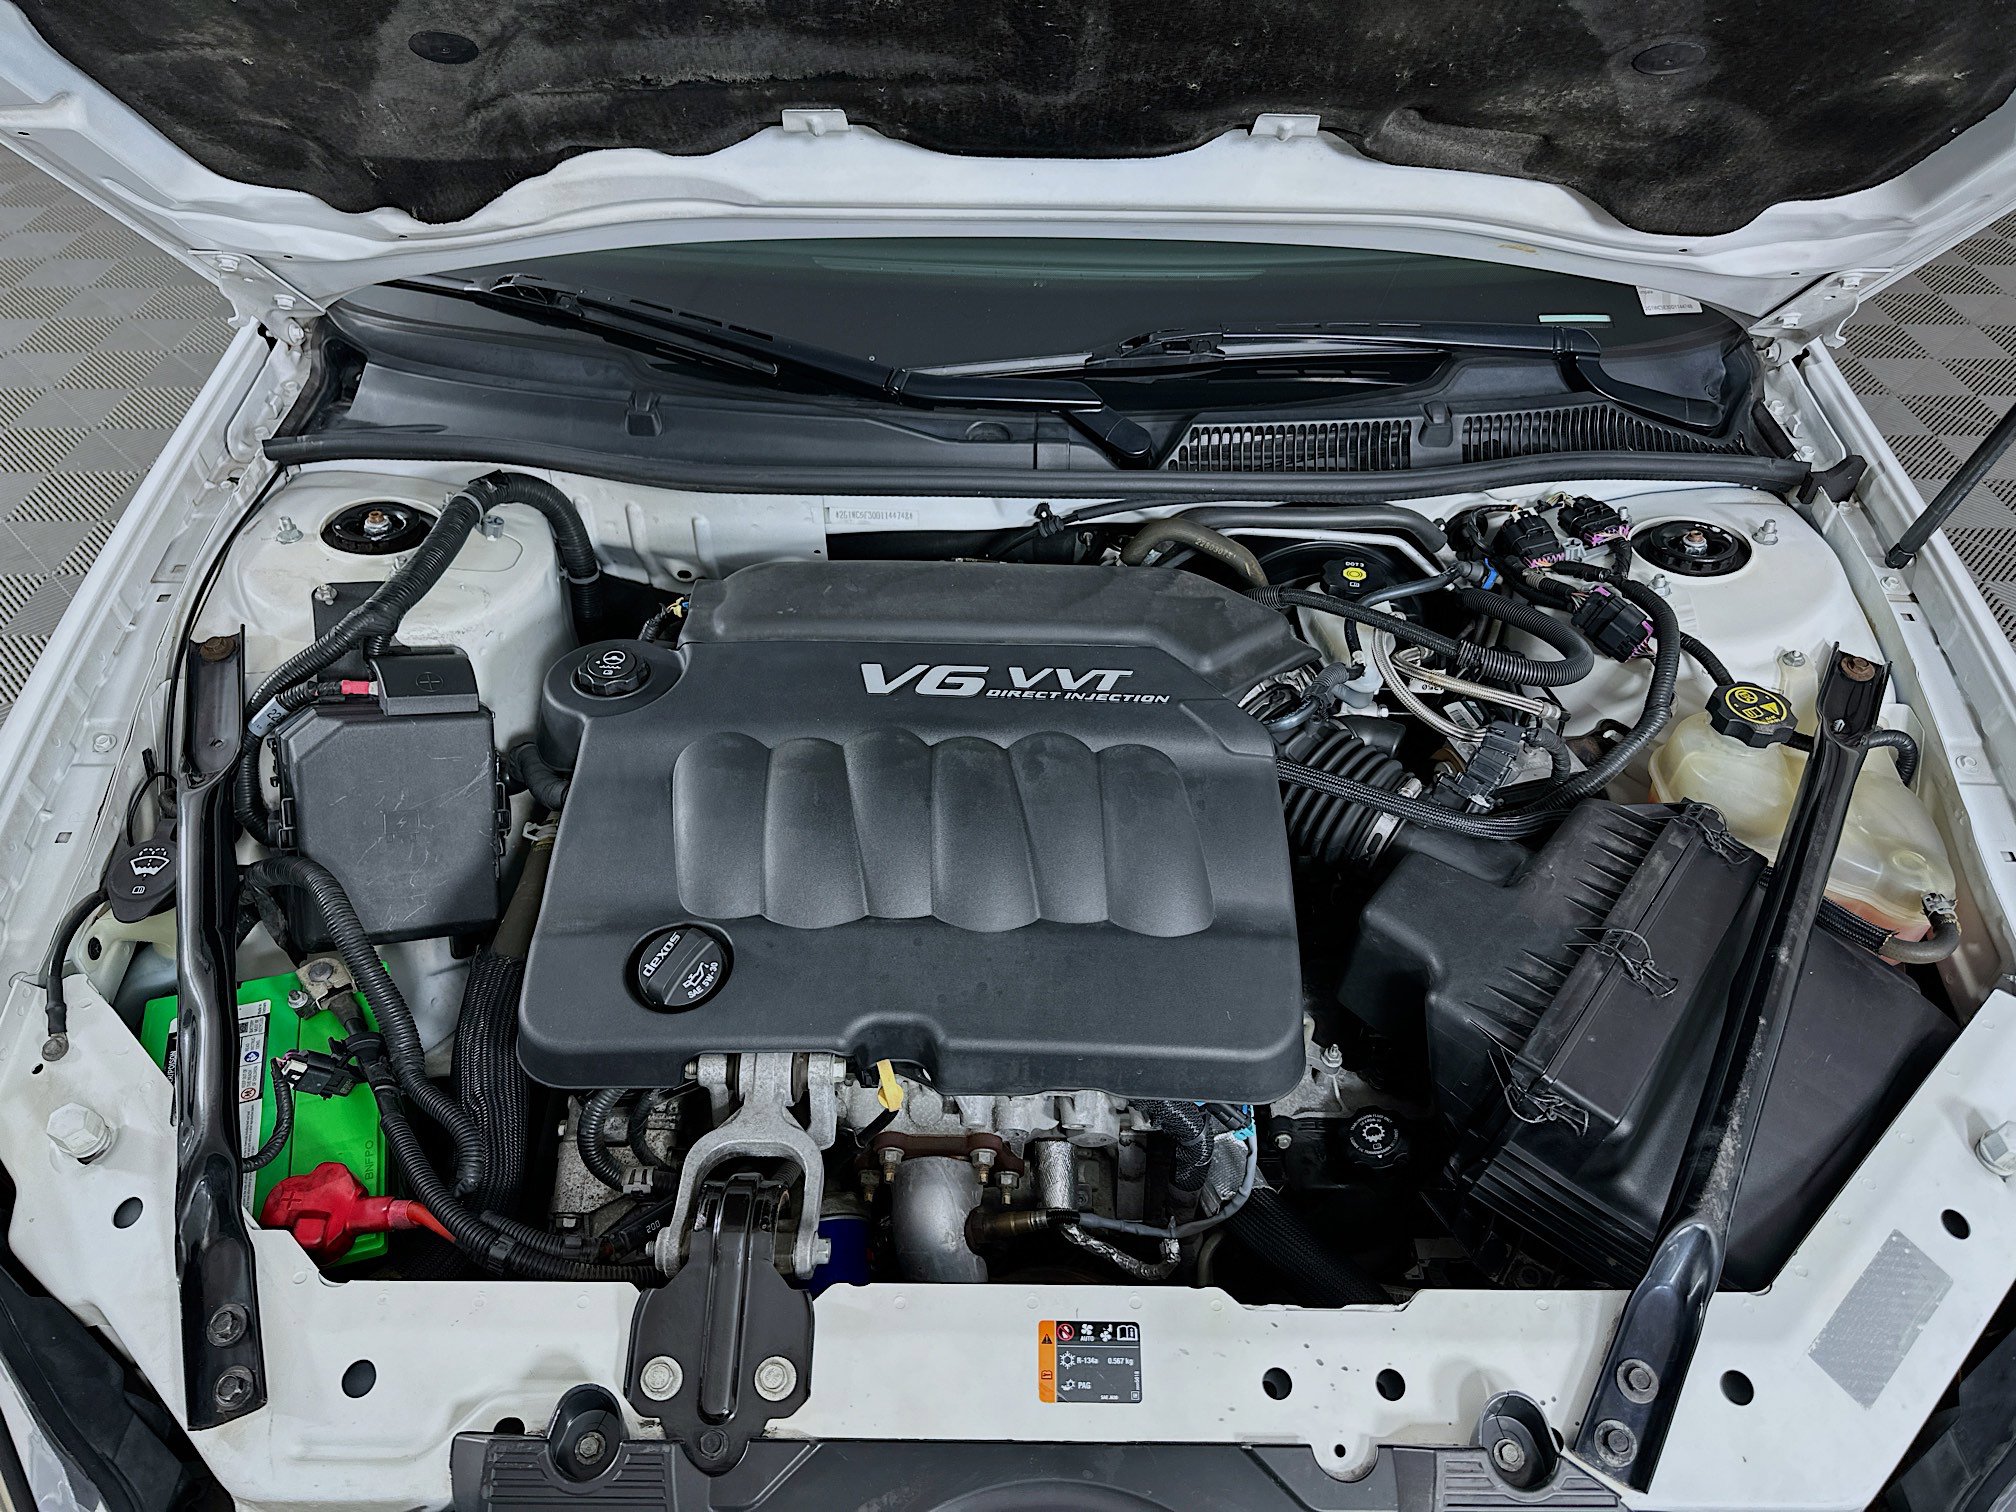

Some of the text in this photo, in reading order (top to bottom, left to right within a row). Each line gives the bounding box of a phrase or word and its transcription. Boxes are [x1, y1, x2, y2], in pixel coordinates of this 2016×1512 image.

[861, 663, 1134, 697] V6 VVT
[986, 689, 1170, 703] DIRECT INJECTION
[642, 931, 681, 978] dexos
[687, 962, 719, 999] SAE 5W-30
[364, 1140, 374, 1180] BNFPO
[1125, 1358, 1134, 1366] kg
[1077, 1381, 1092, 1389] PAG
